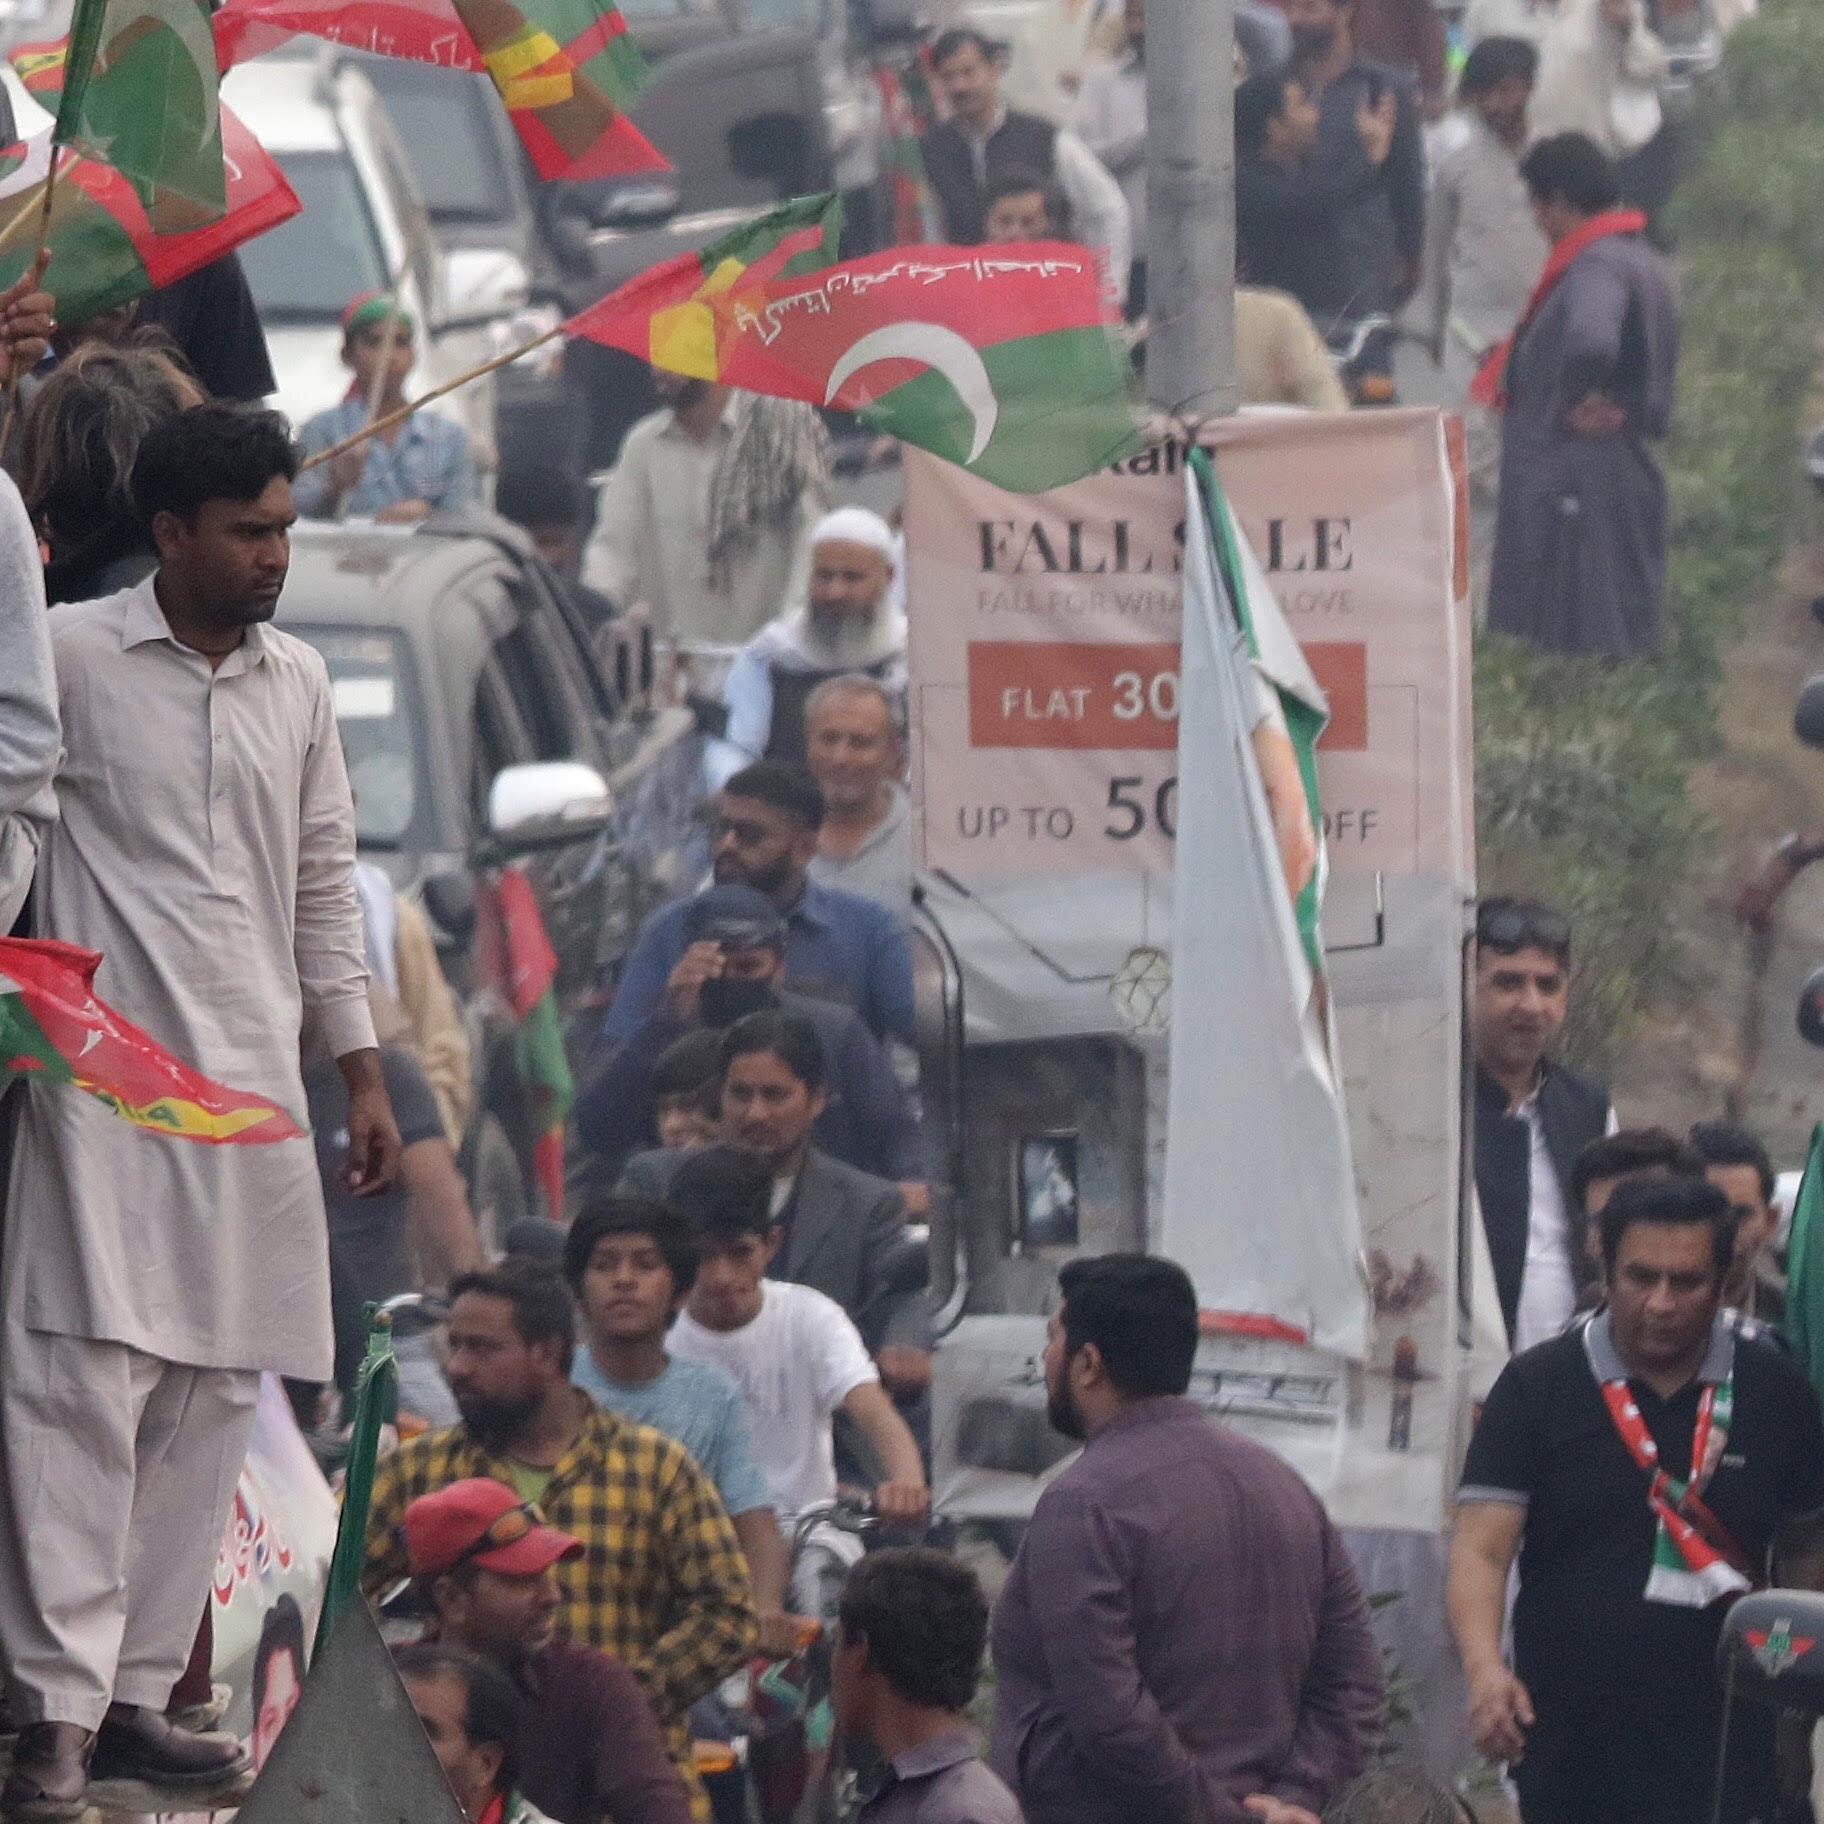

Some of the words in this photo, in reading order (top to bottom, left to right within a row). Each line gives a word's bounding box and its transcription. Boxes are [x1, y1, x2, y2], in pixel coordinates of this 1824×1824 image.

[976, 520, 1155, 574] FALL
[1173, 517, 1353, 573] LE
[1001, 687, 1091, 721] FLAT
[958, 806, 1010, 840] UP
[1019, 806, 1074, 840] TO
